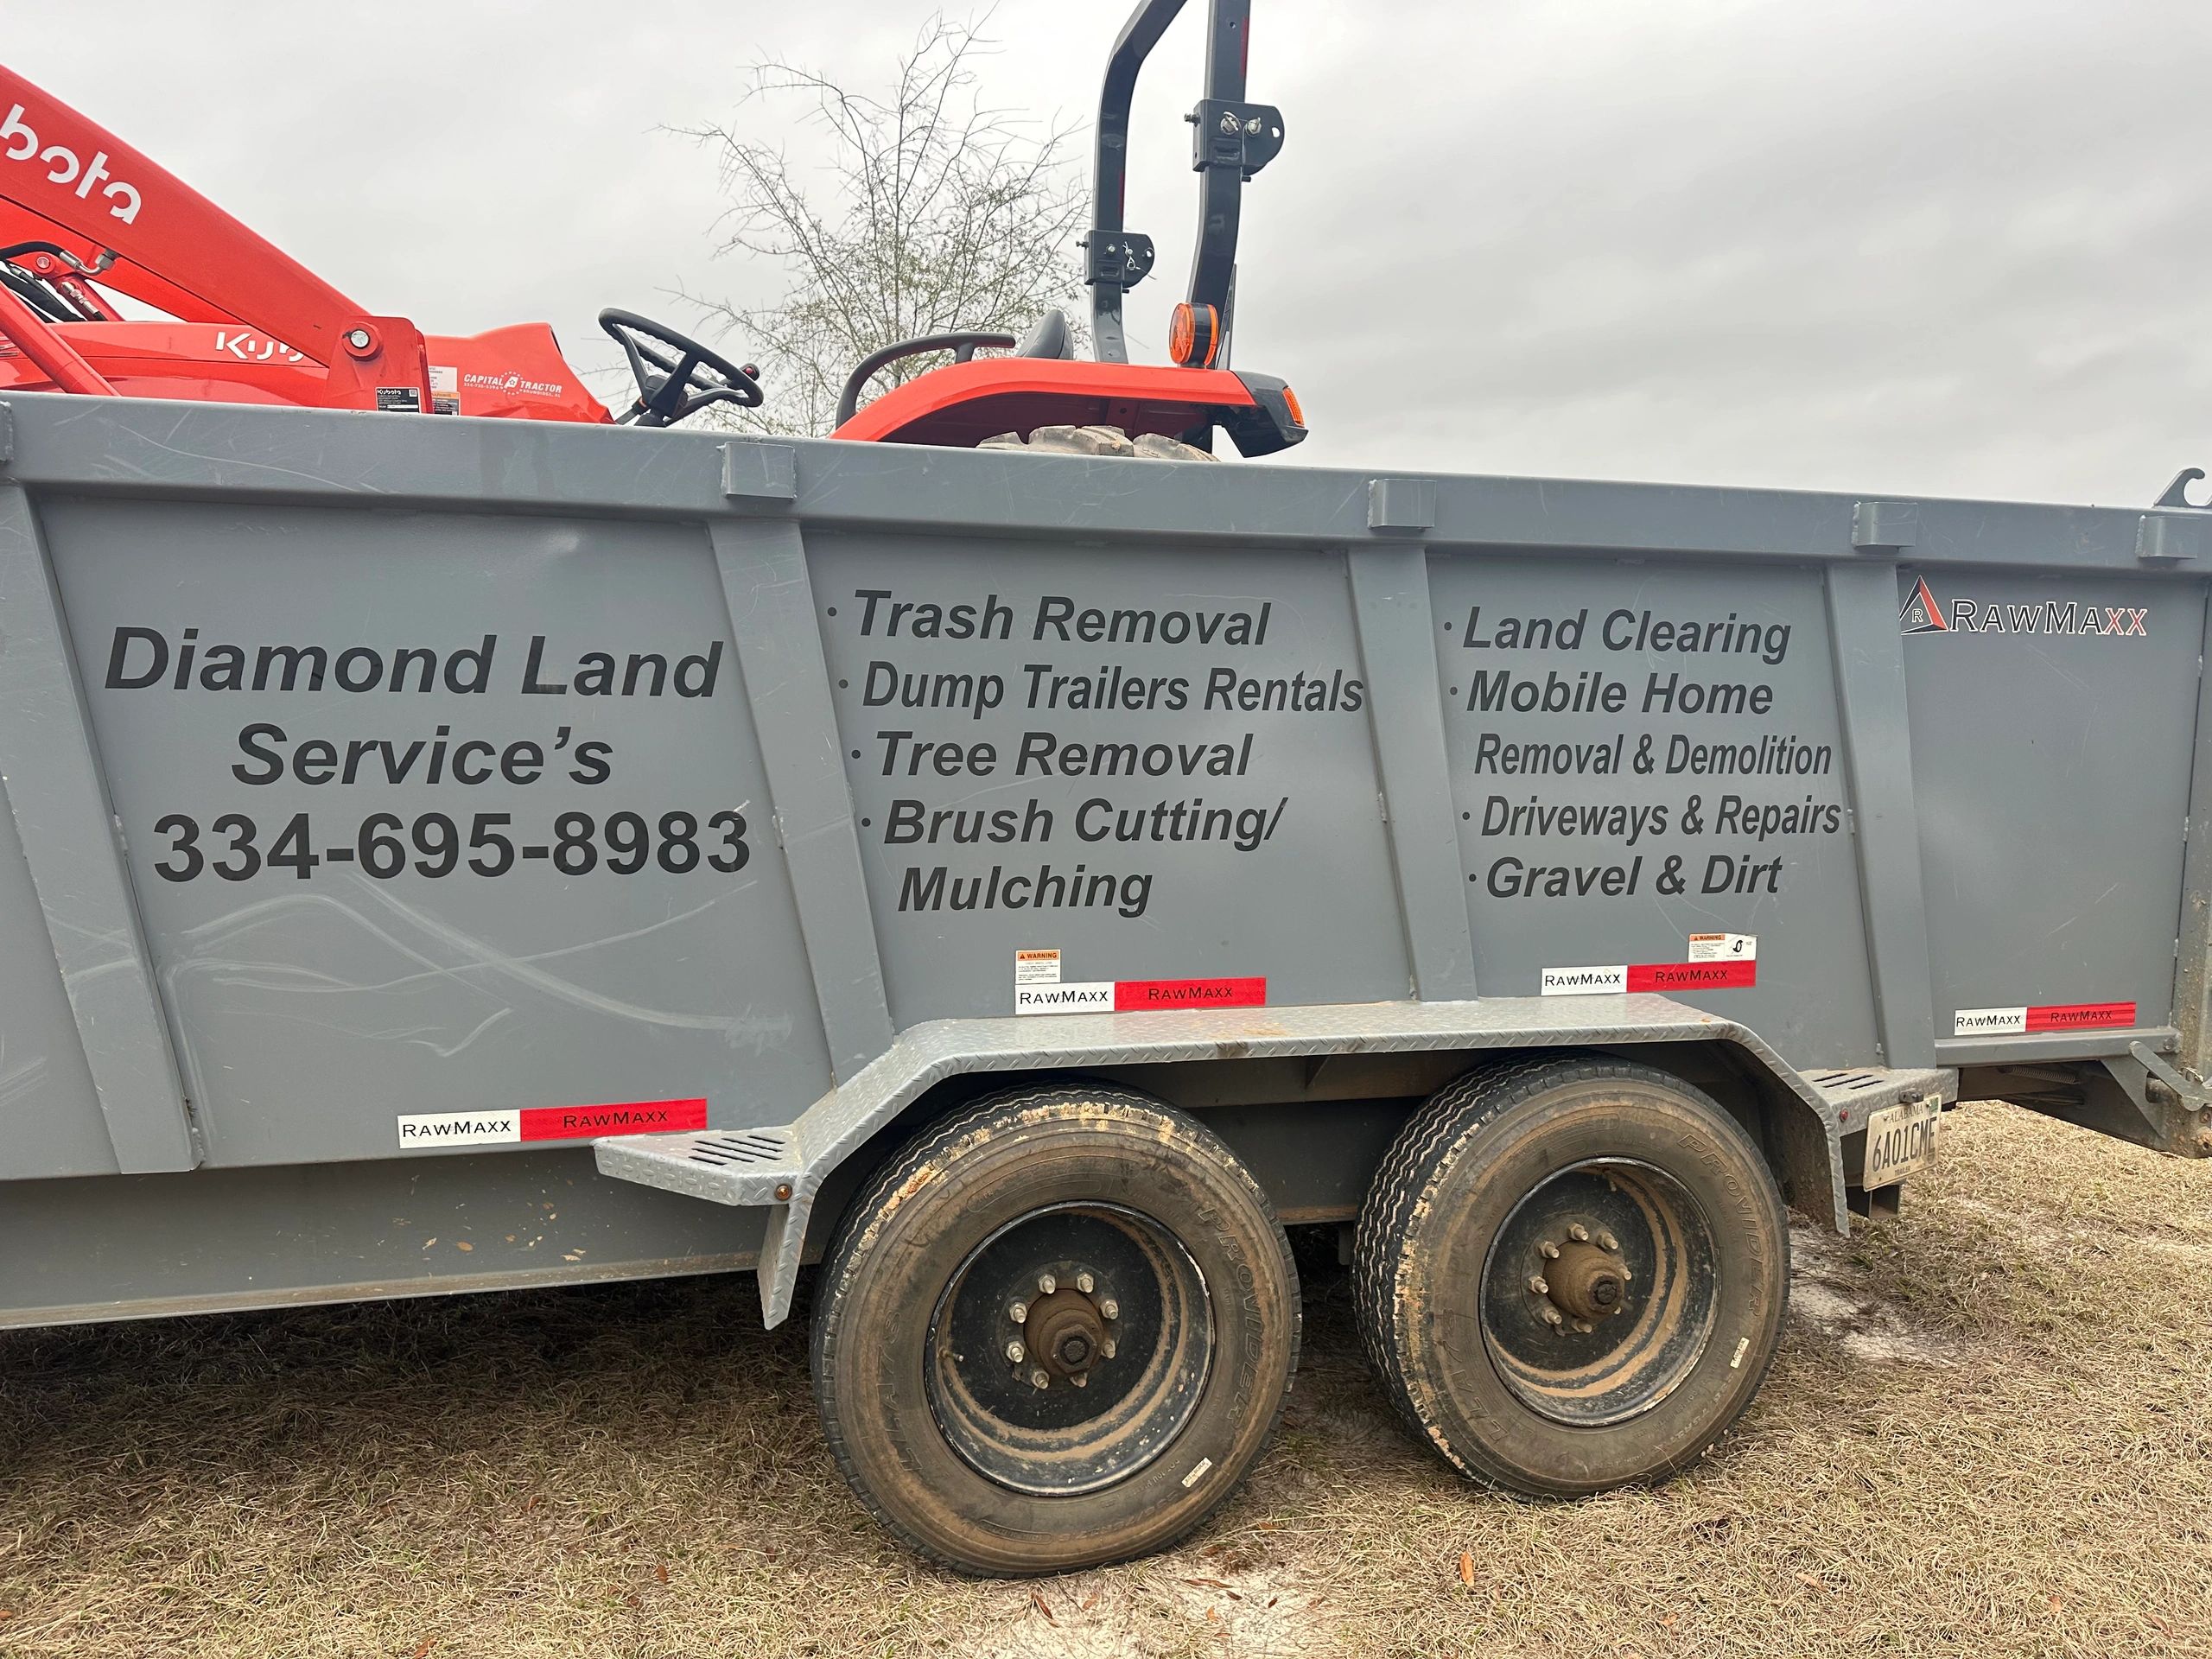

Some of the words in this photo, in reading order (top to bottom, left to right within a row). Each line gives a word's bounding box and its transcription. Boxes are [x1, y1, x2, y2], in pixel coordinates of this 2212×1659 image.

[463, 373, 504, 386] CAPITAL
[520, 380, 563, 394] TRACTOR
[855, 589, 1013, 639] Trash
[1033, 596, 1271, 645] Removal
[1463, 607, 1588, 650] Land
[1603, 609, 1791, 664] Clearing
[105, 627, 497, 694] Diamond
[522, 636, 723, 697] Land
[863, 661, 1003, 720] Dump
[1024, 664, 1189, 710] Trailers
[1204, 668, 1363, 712] Rentals
[1467, 671, 1626, 713] Mobile
[1642, 673, 1773, 715] Home
[232, 723, 613, 785] Service’s
[877, 731, 997, 776] Tree
[1015, 732, 1253, 777] Removal
[1475, 734, 1624, 774] Removal
[1633, 734, 1656, 774] &
[1666, 734, 1832, 774] Demolition
[154, 811, 749, 882] 334-695-8983
[884, 799, 1053, 843] Brush
[1076, 798, 1288, 851] Cutting/
[1482, 795, 1669, 846] Driveways
[1681, 794, 1704, 835] &
[1715, 794, 1841, 842] Repairs
[898, 865, 1153, 918] Mulching
[1487, 855, 1643, 898] Gravel
[1656, 855, 1686, 895] &
[1700, 854, 1783, 893] Dirt
[1890, 1104, 1923, 1123] ALABAMA
[1677, 1134, 1764, 1317] PROVIDER
[1198, 1208, 1263, 1428] PROVIDER
